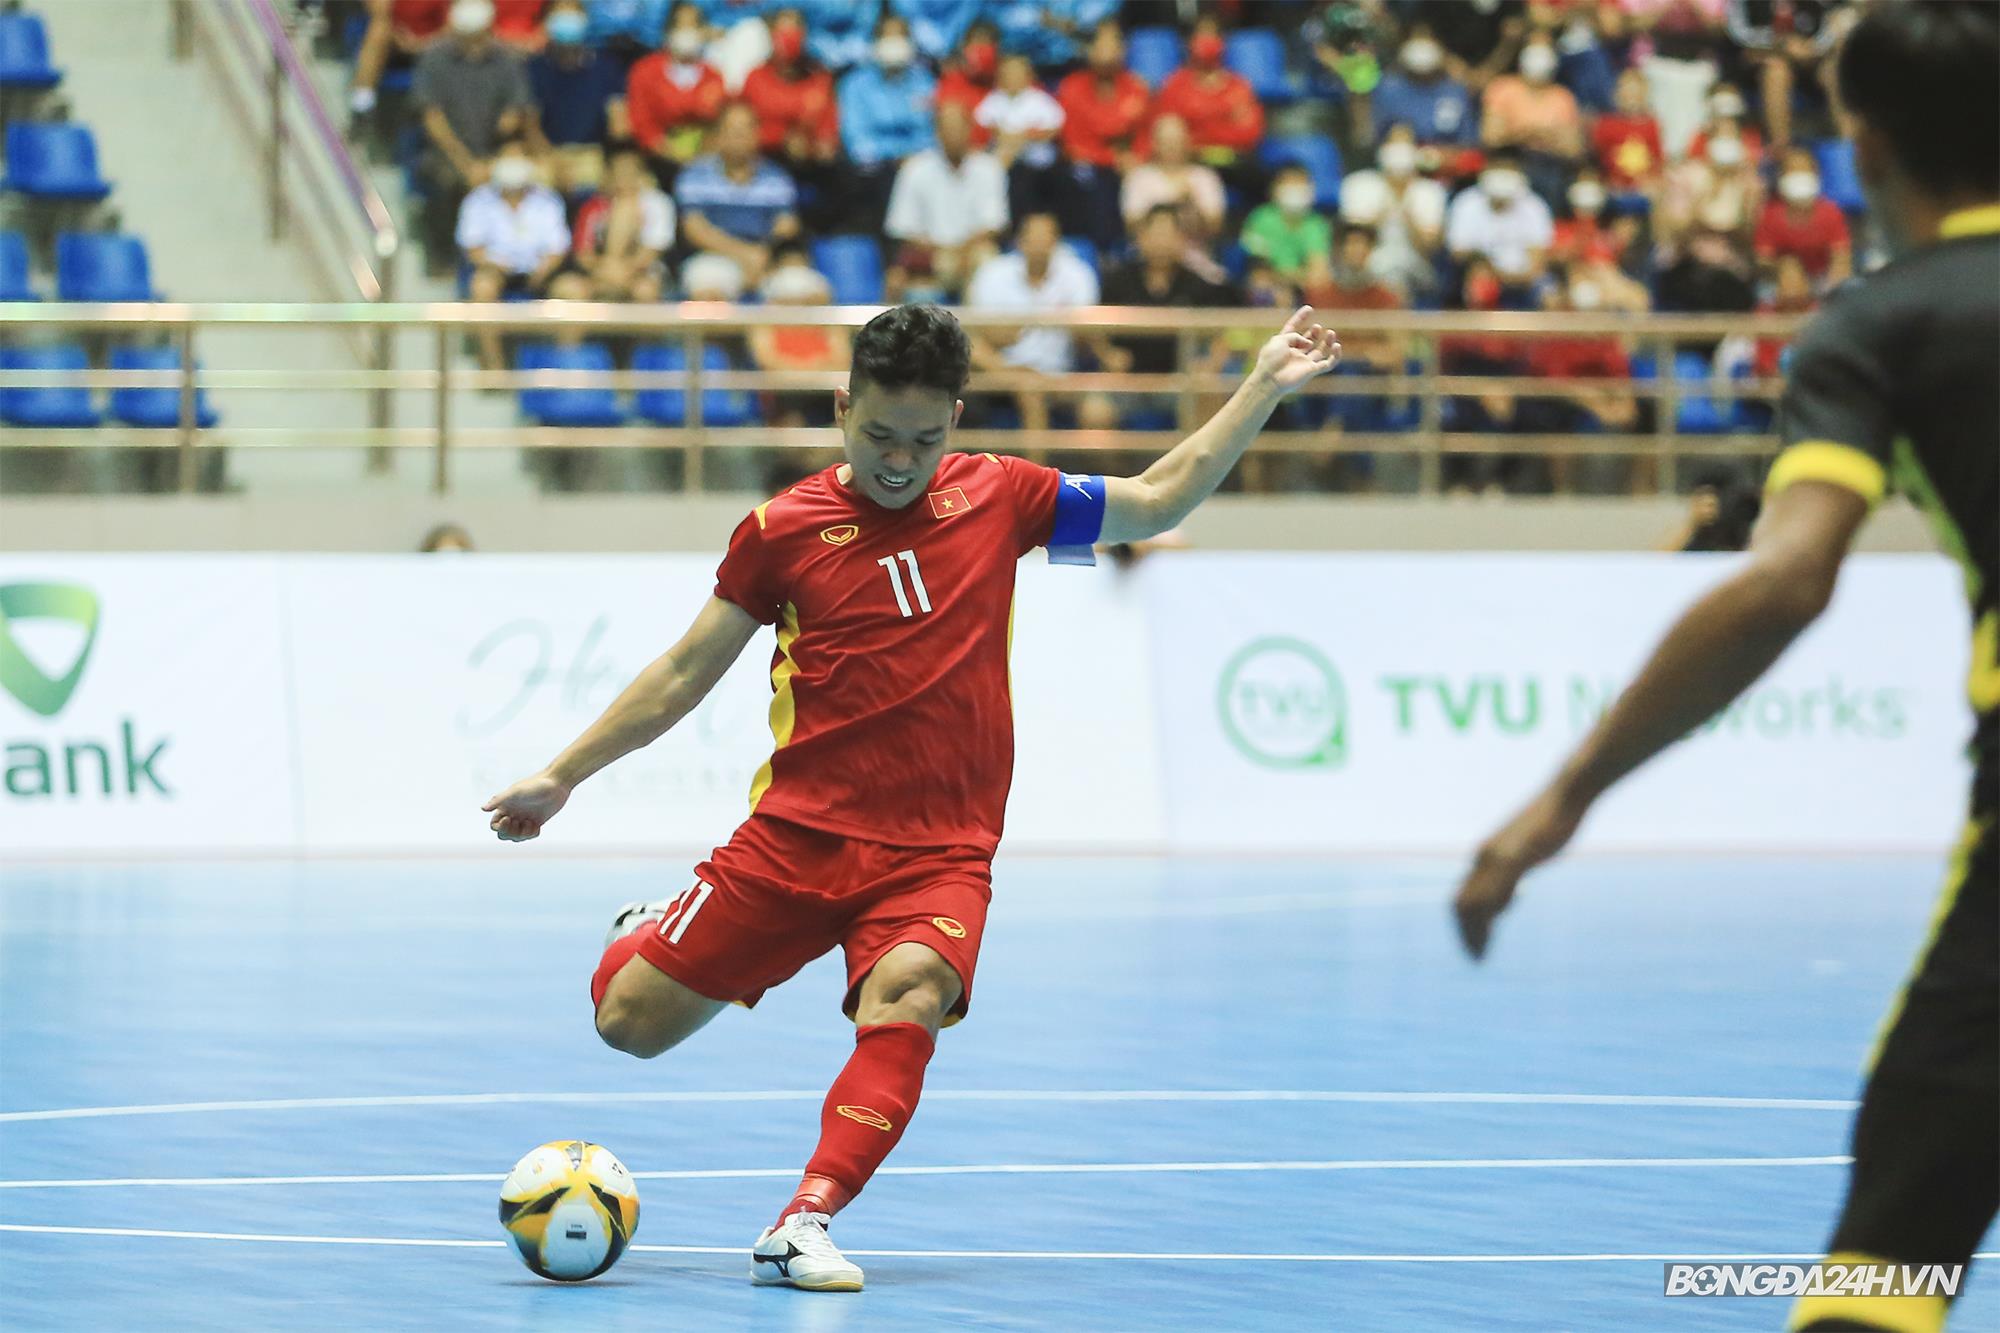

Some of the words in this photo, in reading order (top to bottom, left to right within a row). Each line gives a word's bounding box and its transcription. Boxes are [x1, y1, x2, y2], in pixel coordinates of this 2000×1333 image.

[877, 549, 932, 617] 11
[1380, 676, 1542, 734] TVU
[1566, 672, 1908, 740] Norks
[660, 877, 714, 944] 11
